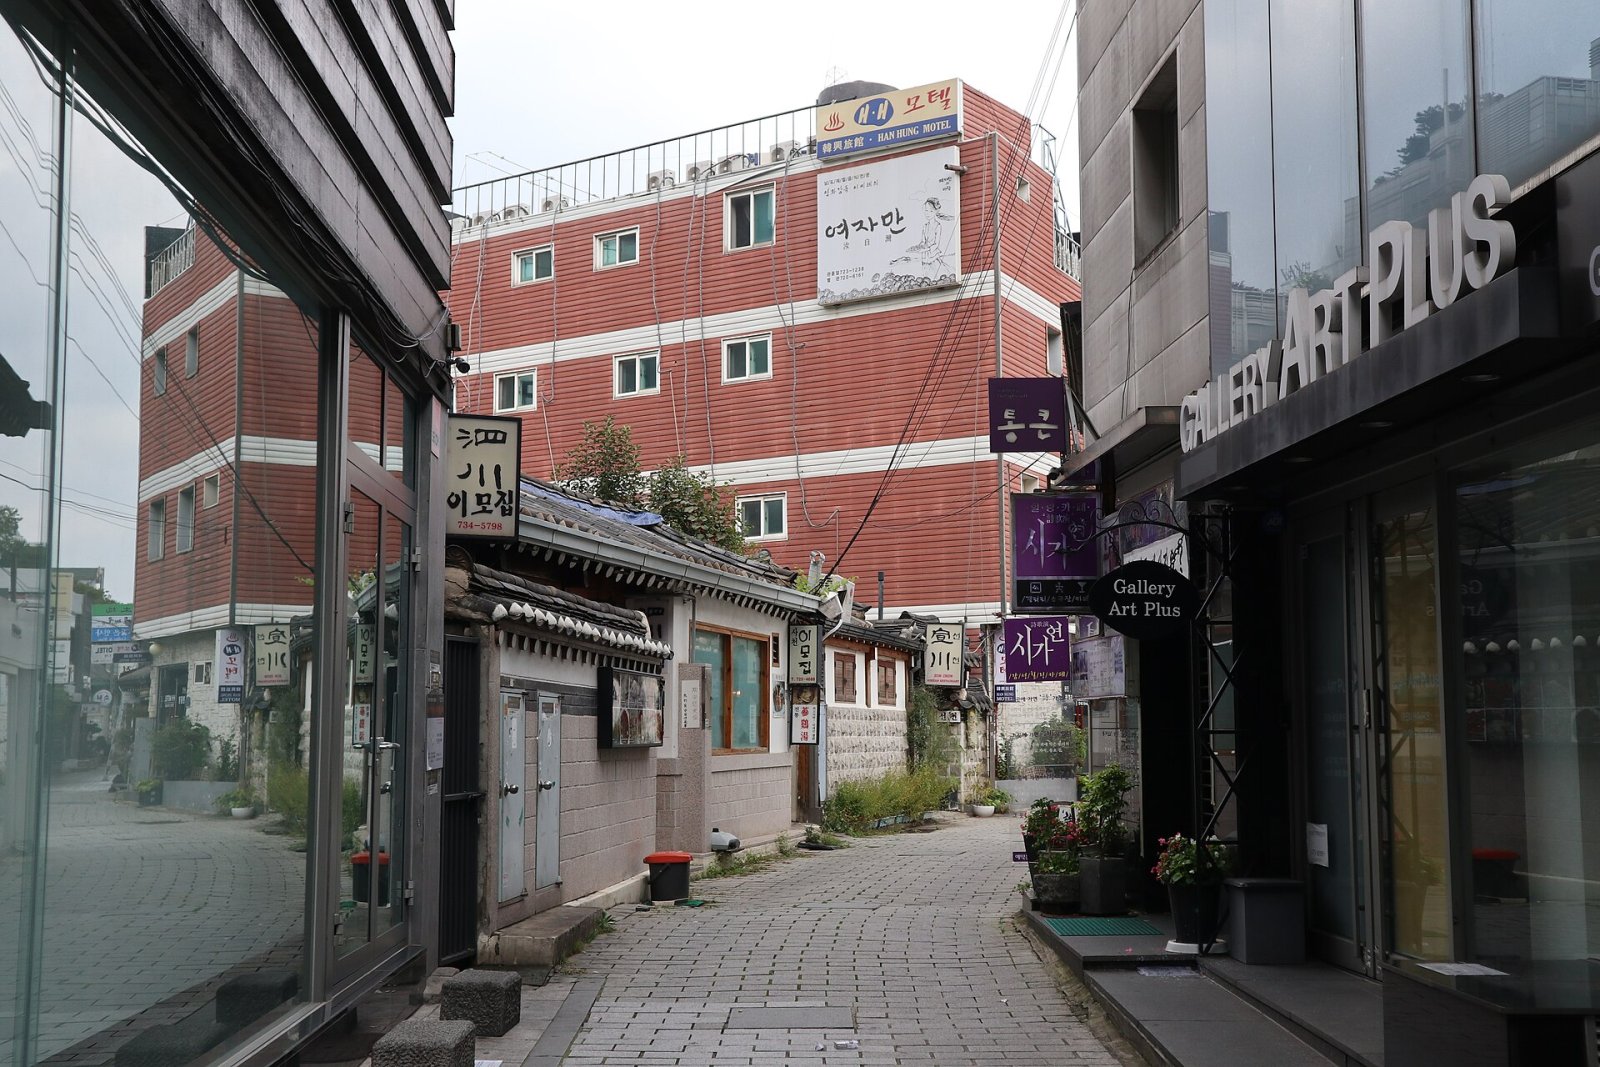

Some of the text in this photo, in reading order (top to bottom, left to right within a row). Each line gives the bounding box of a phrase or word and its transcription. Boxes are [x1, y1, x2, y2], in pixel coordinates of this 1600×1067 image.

[903, 86, 952, 115] 모텔
[821, 136, 865, 154] 韓興旅館
[877, 119, 952, 142] HAN HUNG MOTEL
[825, 207, 907, 240] 여자만
[1179, 174, 1517, 454] GALLERY ART PLUS
[446, 489, 514, 518] 이모집
[457, 520, 503, 531] 734-5798
[1113, 579, 1176, 598] Gallery
[1108, 601, 1181, 617] Art Plus
[798, 629, 811, 675] 이모집
[930, 627, 953, 671] 宣川
[1009, 621, 1065, 666] 시가연
